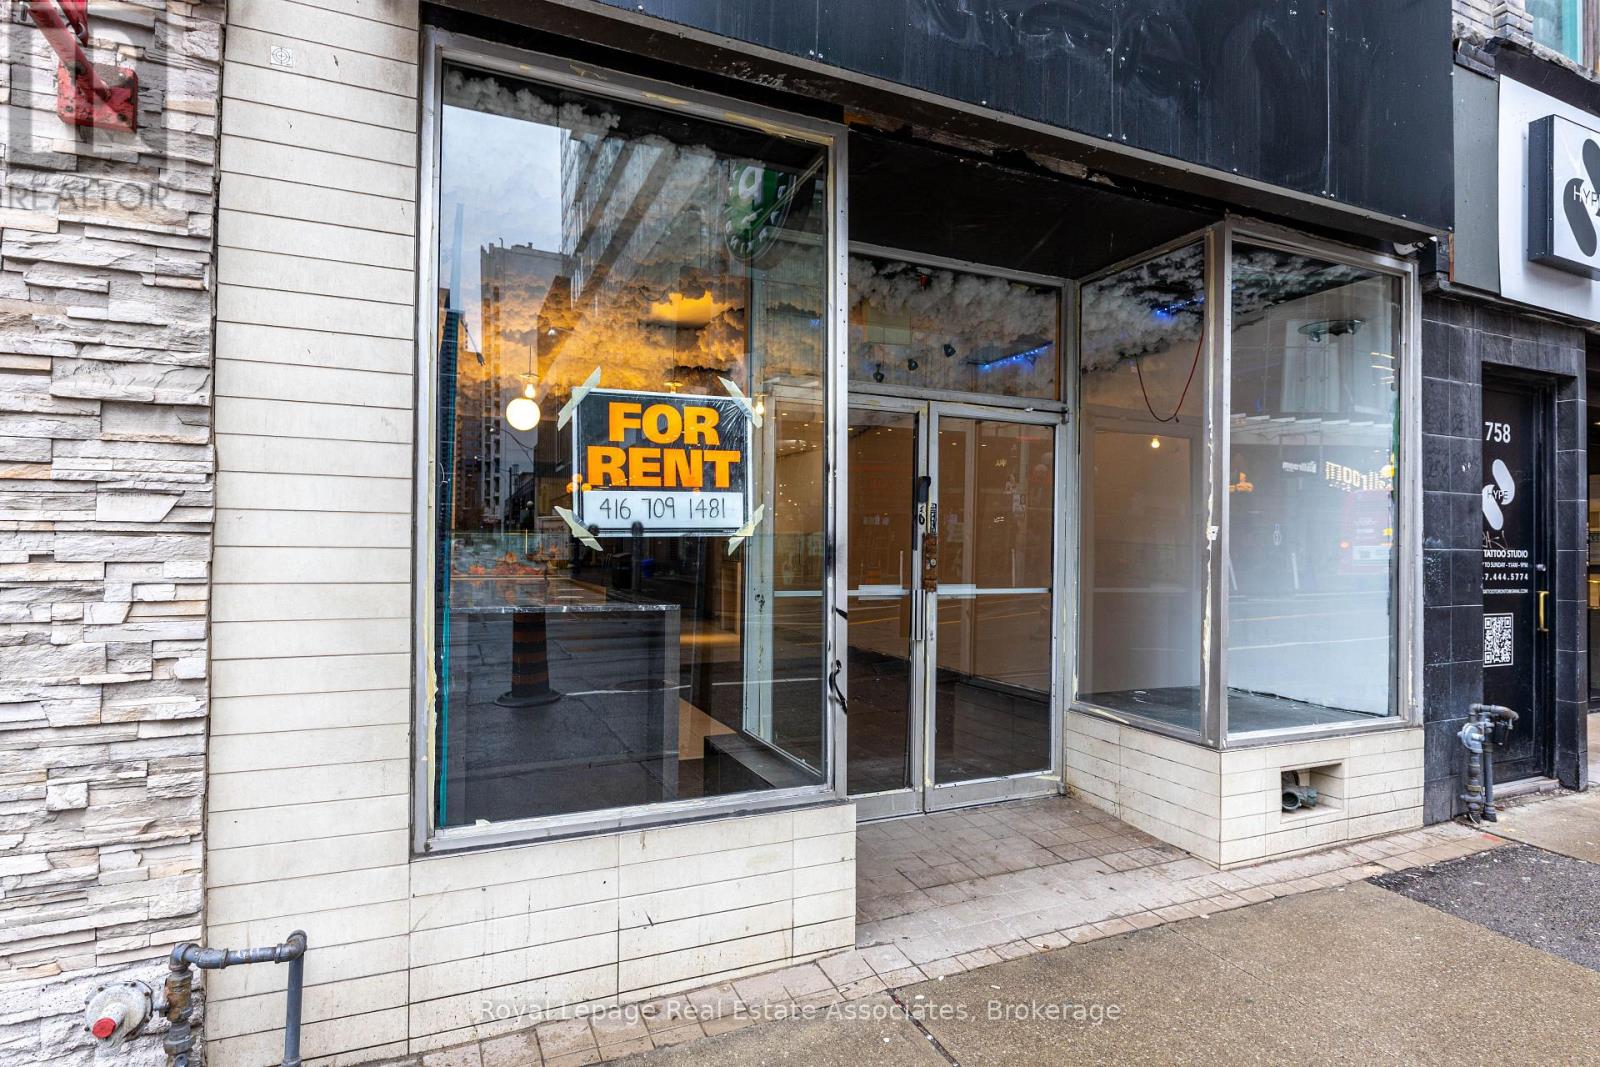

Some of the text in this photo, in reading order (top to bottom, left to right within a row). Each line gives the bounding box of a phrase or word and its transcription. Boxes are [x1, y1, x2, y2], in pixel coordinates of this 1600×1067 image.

[1573, 184, 1600, 206] HYP
[608, 402, 721, 446] FOR
[1485, 421, 1511, 443] 758
[587, 445, 741, 488] RENT
[1487, 490, 1509, 500] HYPE
[600, 497, 725, 520] 416 709 1481
[1484, 549, 1528, 558] TATTOO STUDIO
